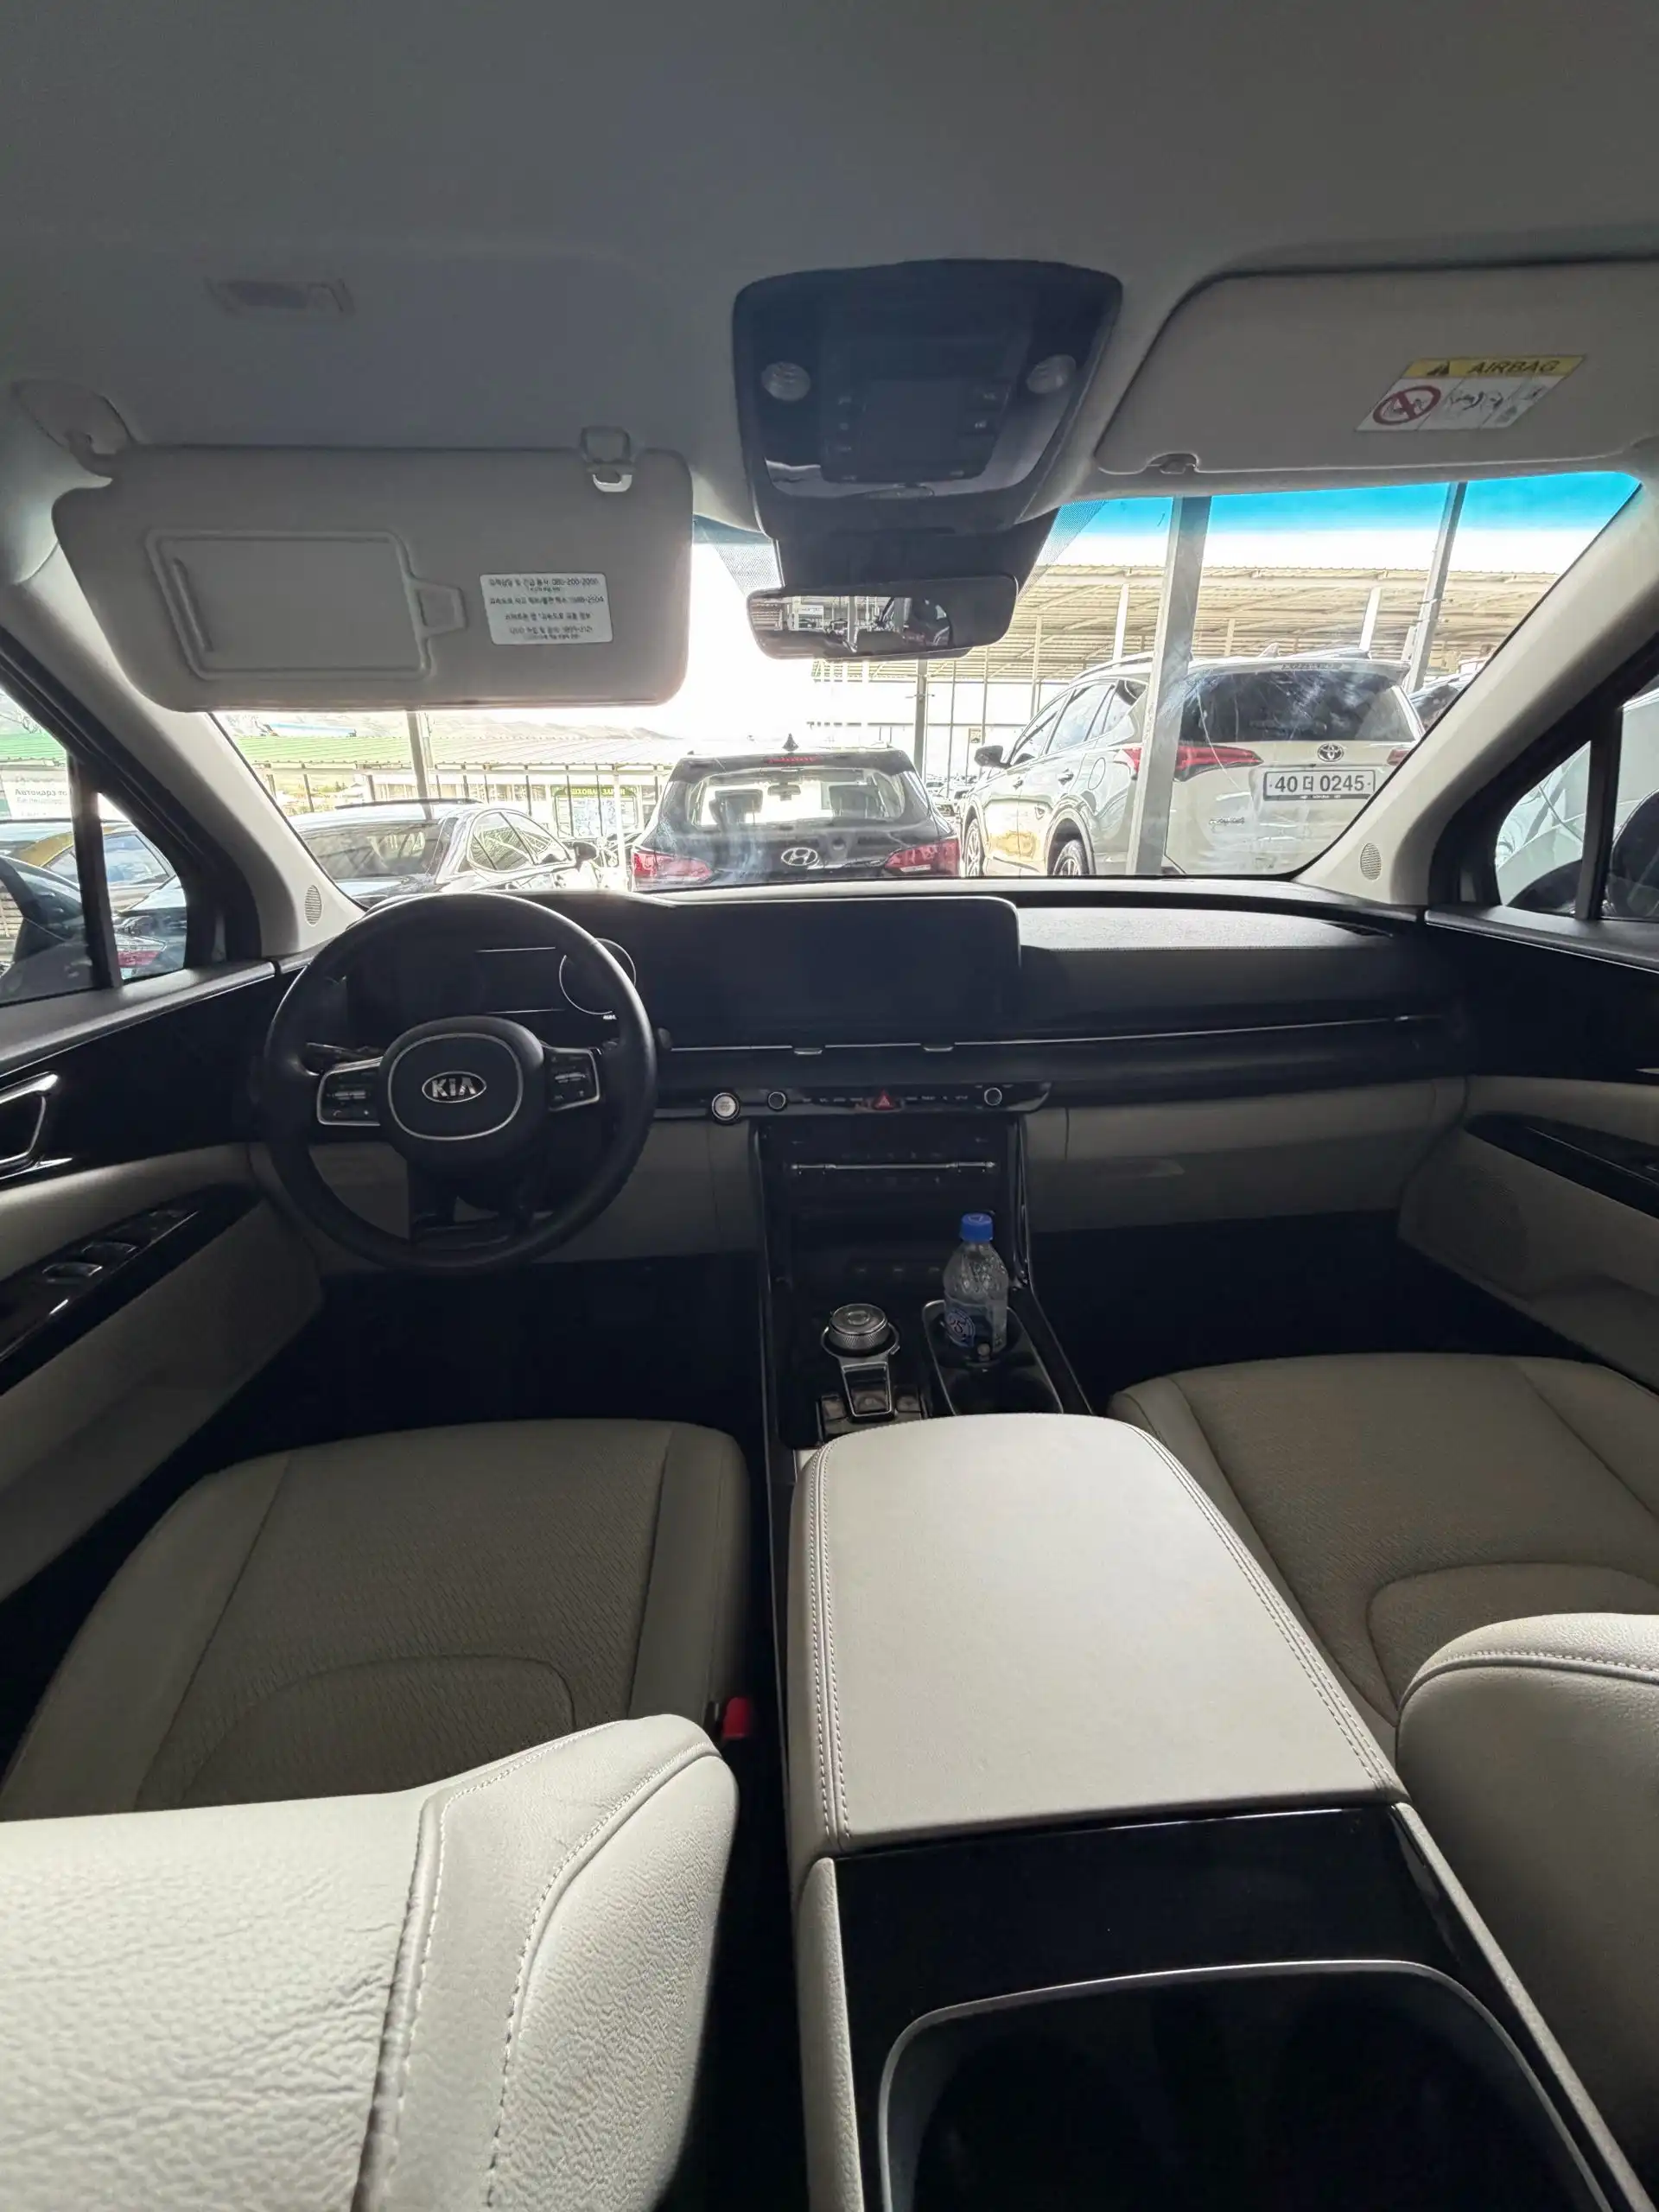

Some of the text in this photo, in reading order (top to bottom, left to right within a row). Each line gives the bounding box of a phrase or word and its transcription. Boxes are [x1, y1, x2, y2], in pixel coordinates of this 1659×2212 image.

[1466, 359, 1560, 375] AIRBAG
[1319, 774, 1364, 791] 0245
[430, 1077, 476, 1098] KIA
